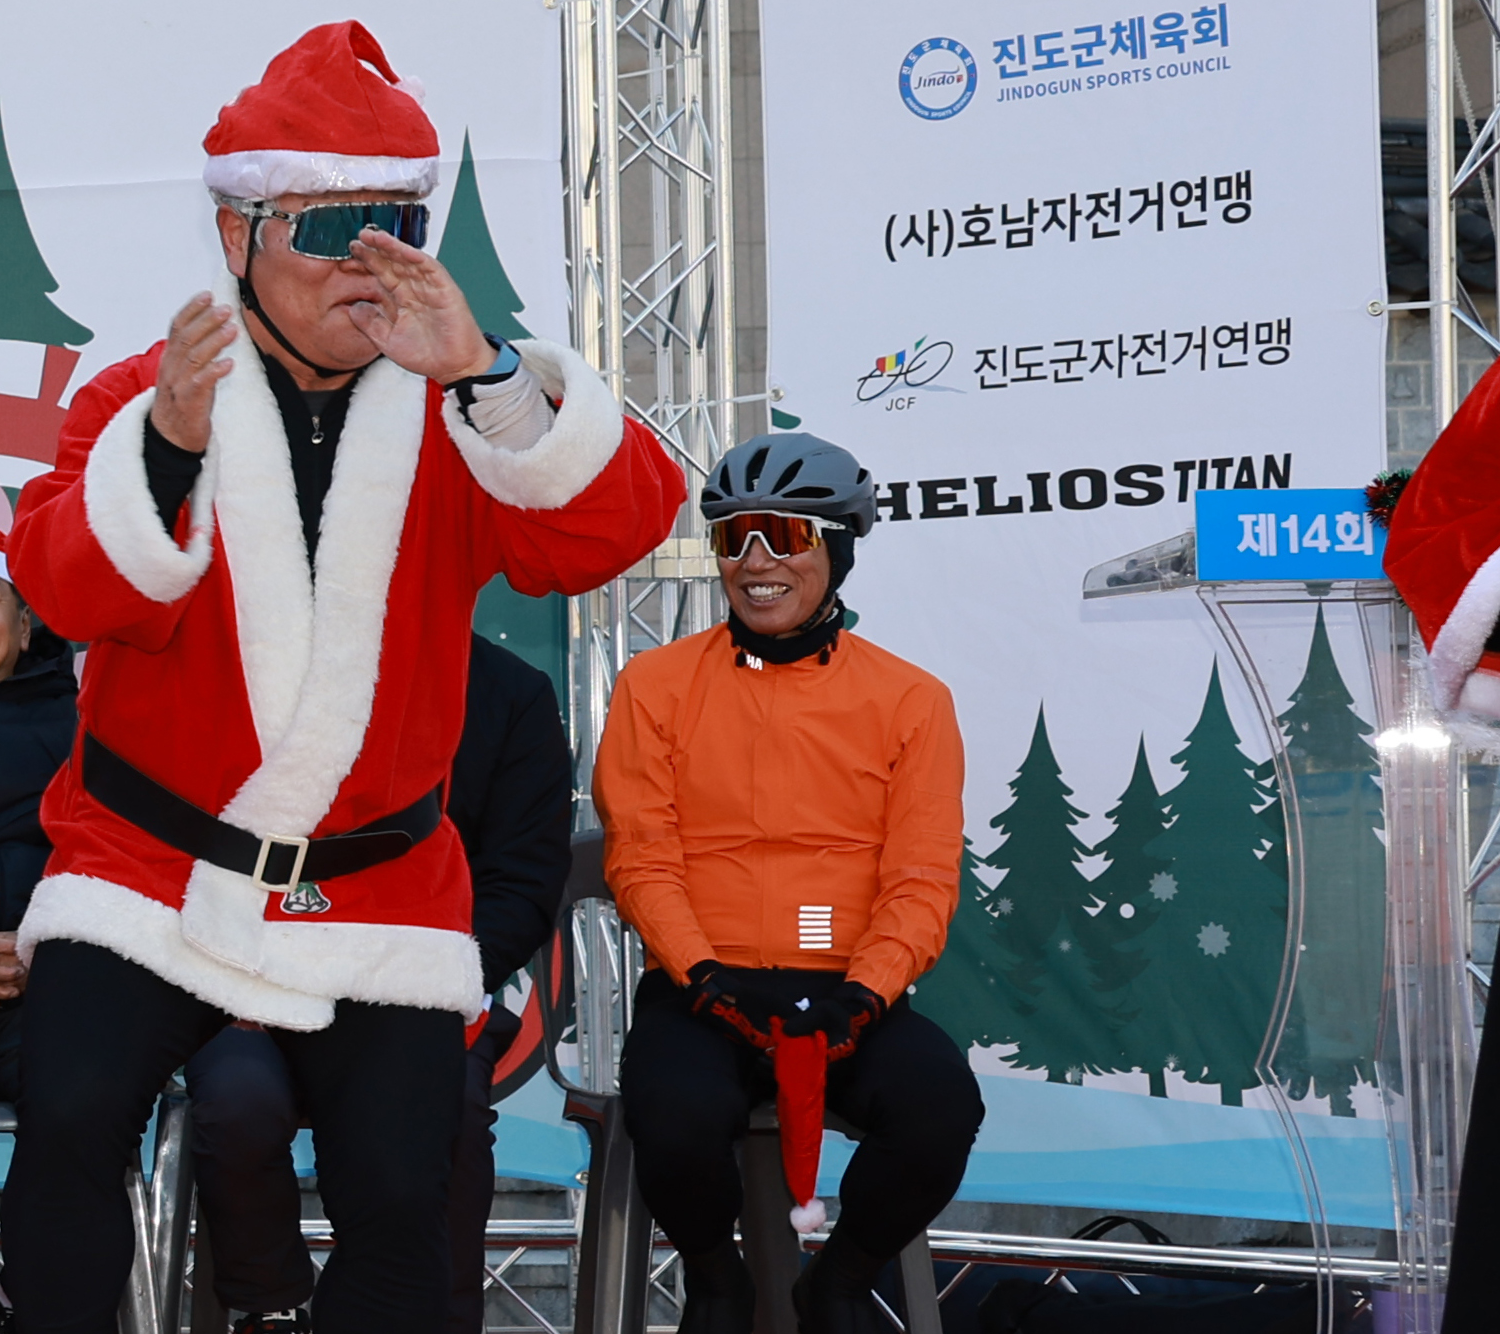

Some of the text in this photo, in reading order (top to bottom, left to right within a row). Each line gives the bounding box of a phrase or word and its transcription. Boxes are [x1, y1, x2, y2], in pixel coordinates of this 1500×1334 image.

[991, 2, 1229, 79] 진도군체육회
[996, 56, 1231, 102] JINDOGUN SPORTS COUNCIL
[885, 170, 1252, 262] (사)호남자전거연맹
[973, 316, 1292, 390] 진도군자전거연맹
[885, 396, 916, 411] JCF
[875, 453, 1292, 522] HELIOS TITAN
[1236, 511, 1374, 556] 제14회
